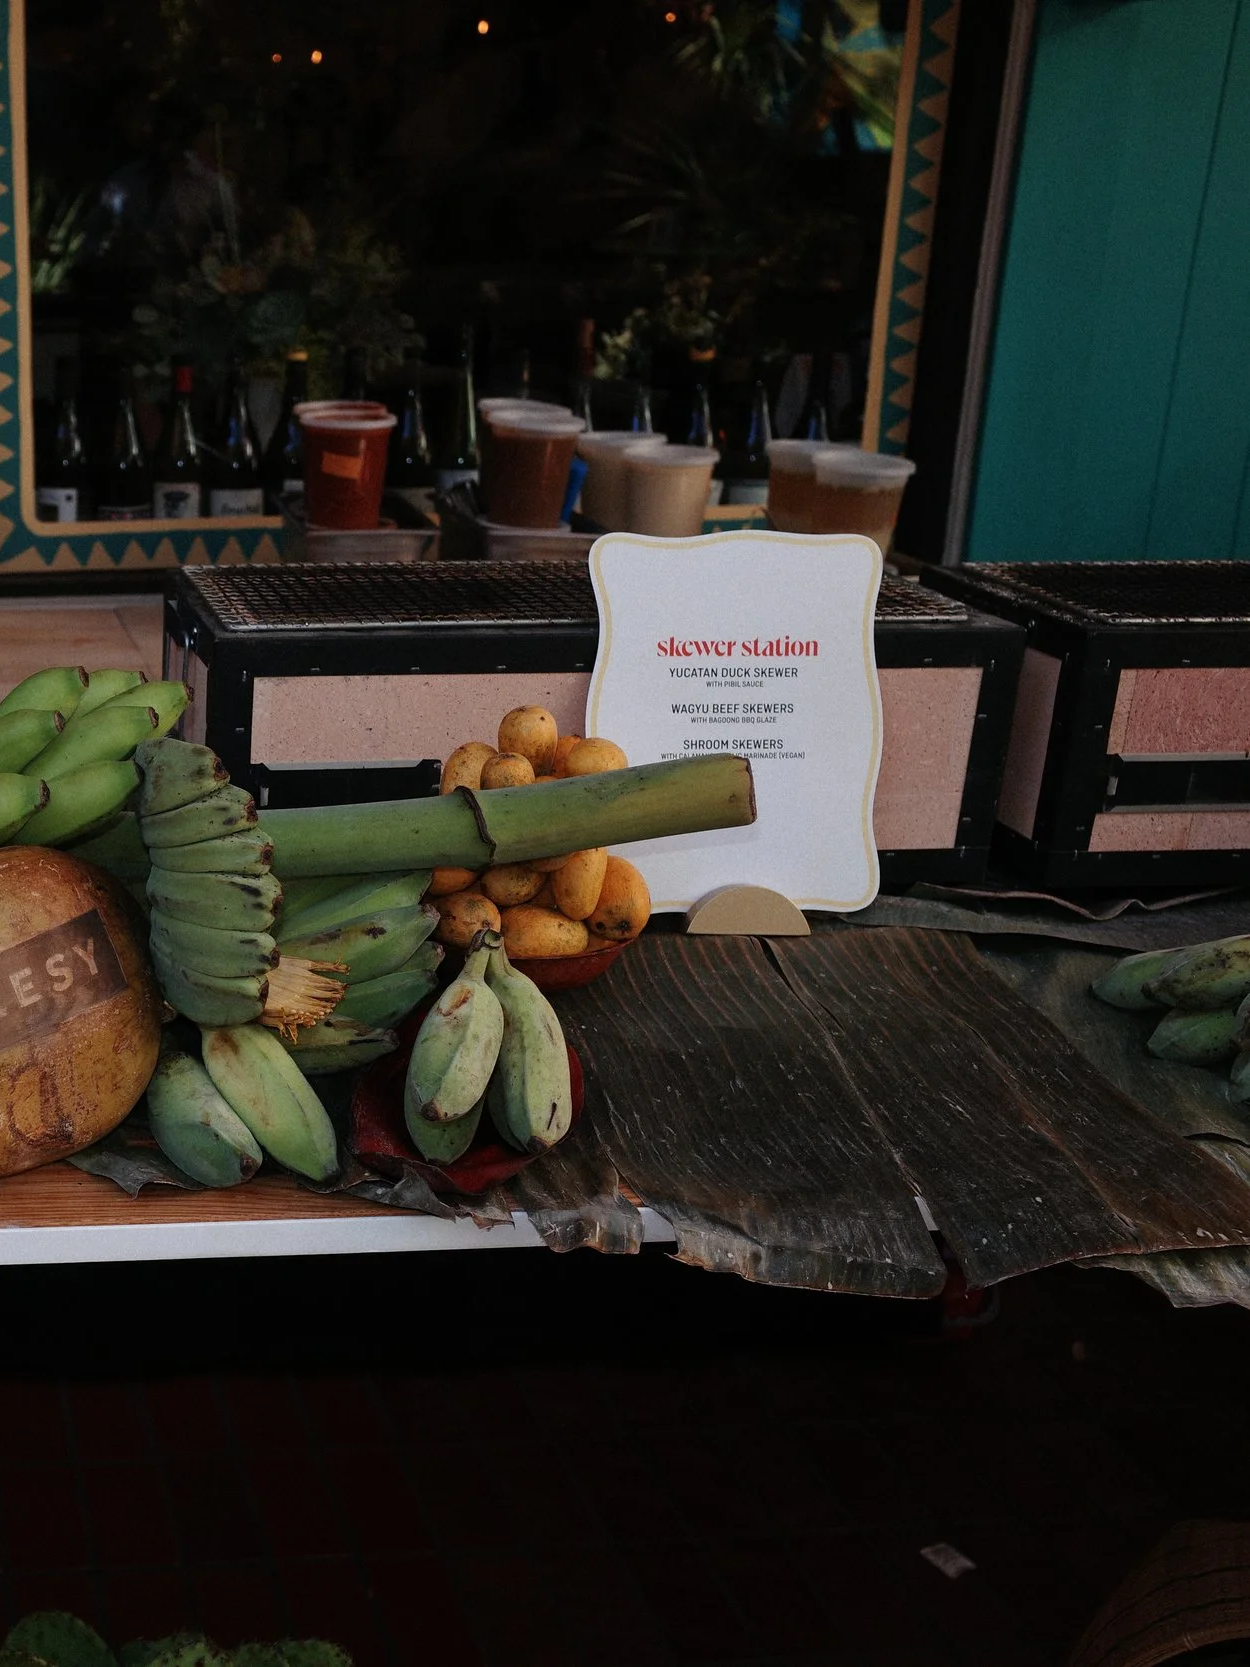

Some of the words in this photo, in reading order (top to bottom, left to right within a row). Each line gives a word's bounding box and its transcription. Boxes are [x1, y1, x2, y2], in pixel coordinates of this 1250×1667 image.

[657, 635, 737, 657] skewer
[741, 635, 818, 657] station
[669, 667, 718, 678] YUCATAN
[721, 667, 750, 678] DUCK
[753, 667, 798, 678] SKEWER
[706, 680, 723, 688] WITH
[724, 680, 741, 688] PIBIL
[742, 680, 764, 688] SAUCE
[671, 703, 709, 714] WAGYU
[712, 703, 740, 714] BEEF
[742, 703, 794, 714] SKEWERS
[690, 716, 707, 724] WITH
[708, 716, 740, 724] BAGOONG
[741, 716, 755, 725] BBQ
[756, 716, 777, 724] GLAZE
[683, 739, 729, 750] SHROOM
[731, 739, 784, 750] SKEWERS
[661, 752, 678, 760] WITH
[744, 752, 778, 760] MARINADE
